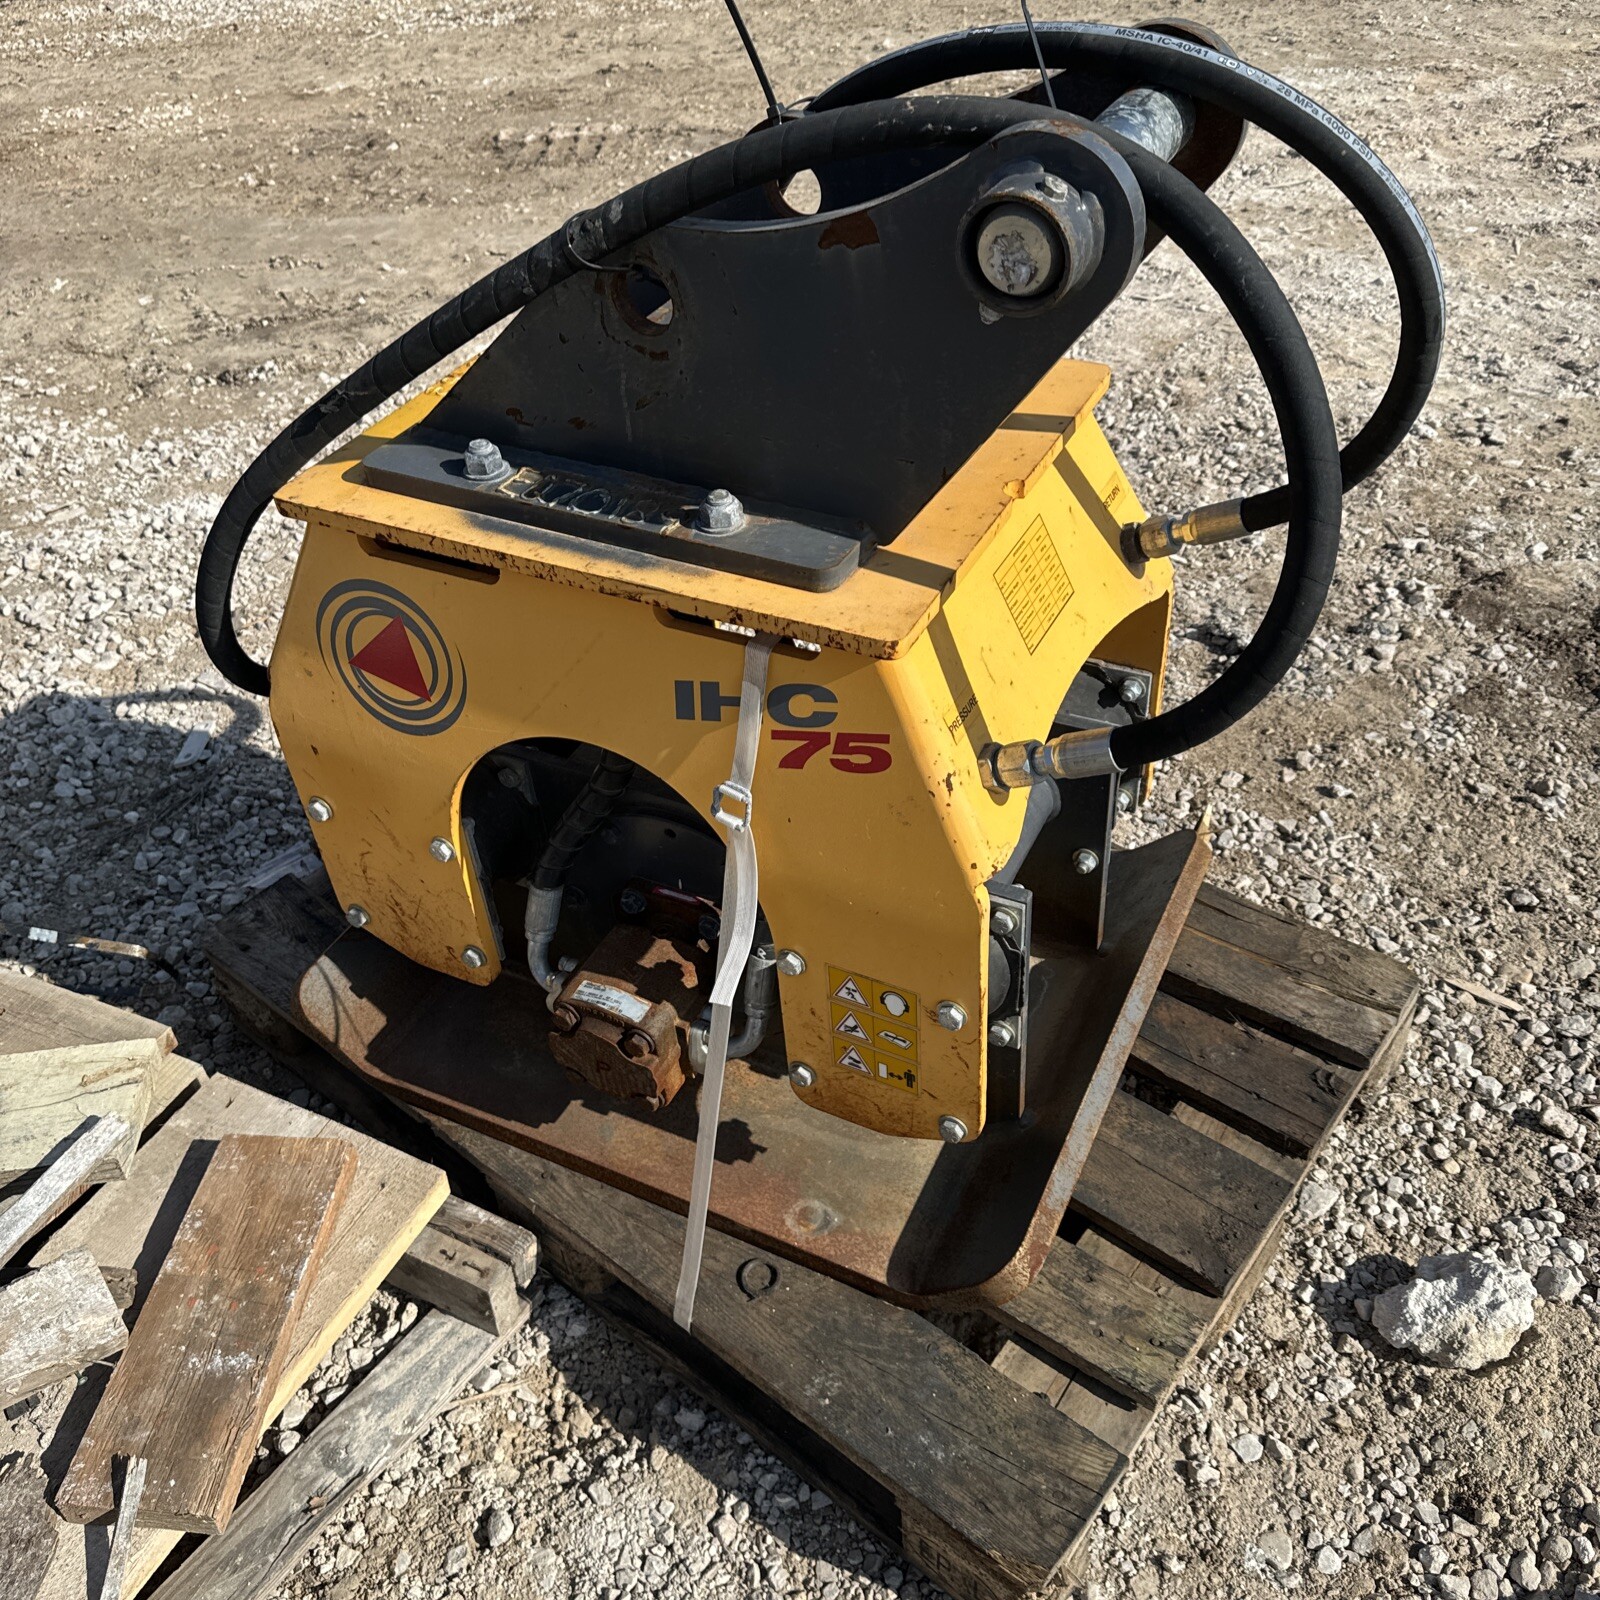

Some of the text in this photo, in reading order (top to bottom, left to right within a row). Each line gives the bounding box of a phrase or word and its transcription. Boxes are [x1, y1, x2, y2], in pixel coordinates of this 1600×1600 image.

[1115, 28, 1209, 58] MSHA IC-40/41
[1276, 84, 1373, 161] 28 MPa (4000 PSI)
[1102, 484, 1121, 511] RETURN
[948, 693, 979, 734] PRESSURE
[770, 729, 893, 774] 75
